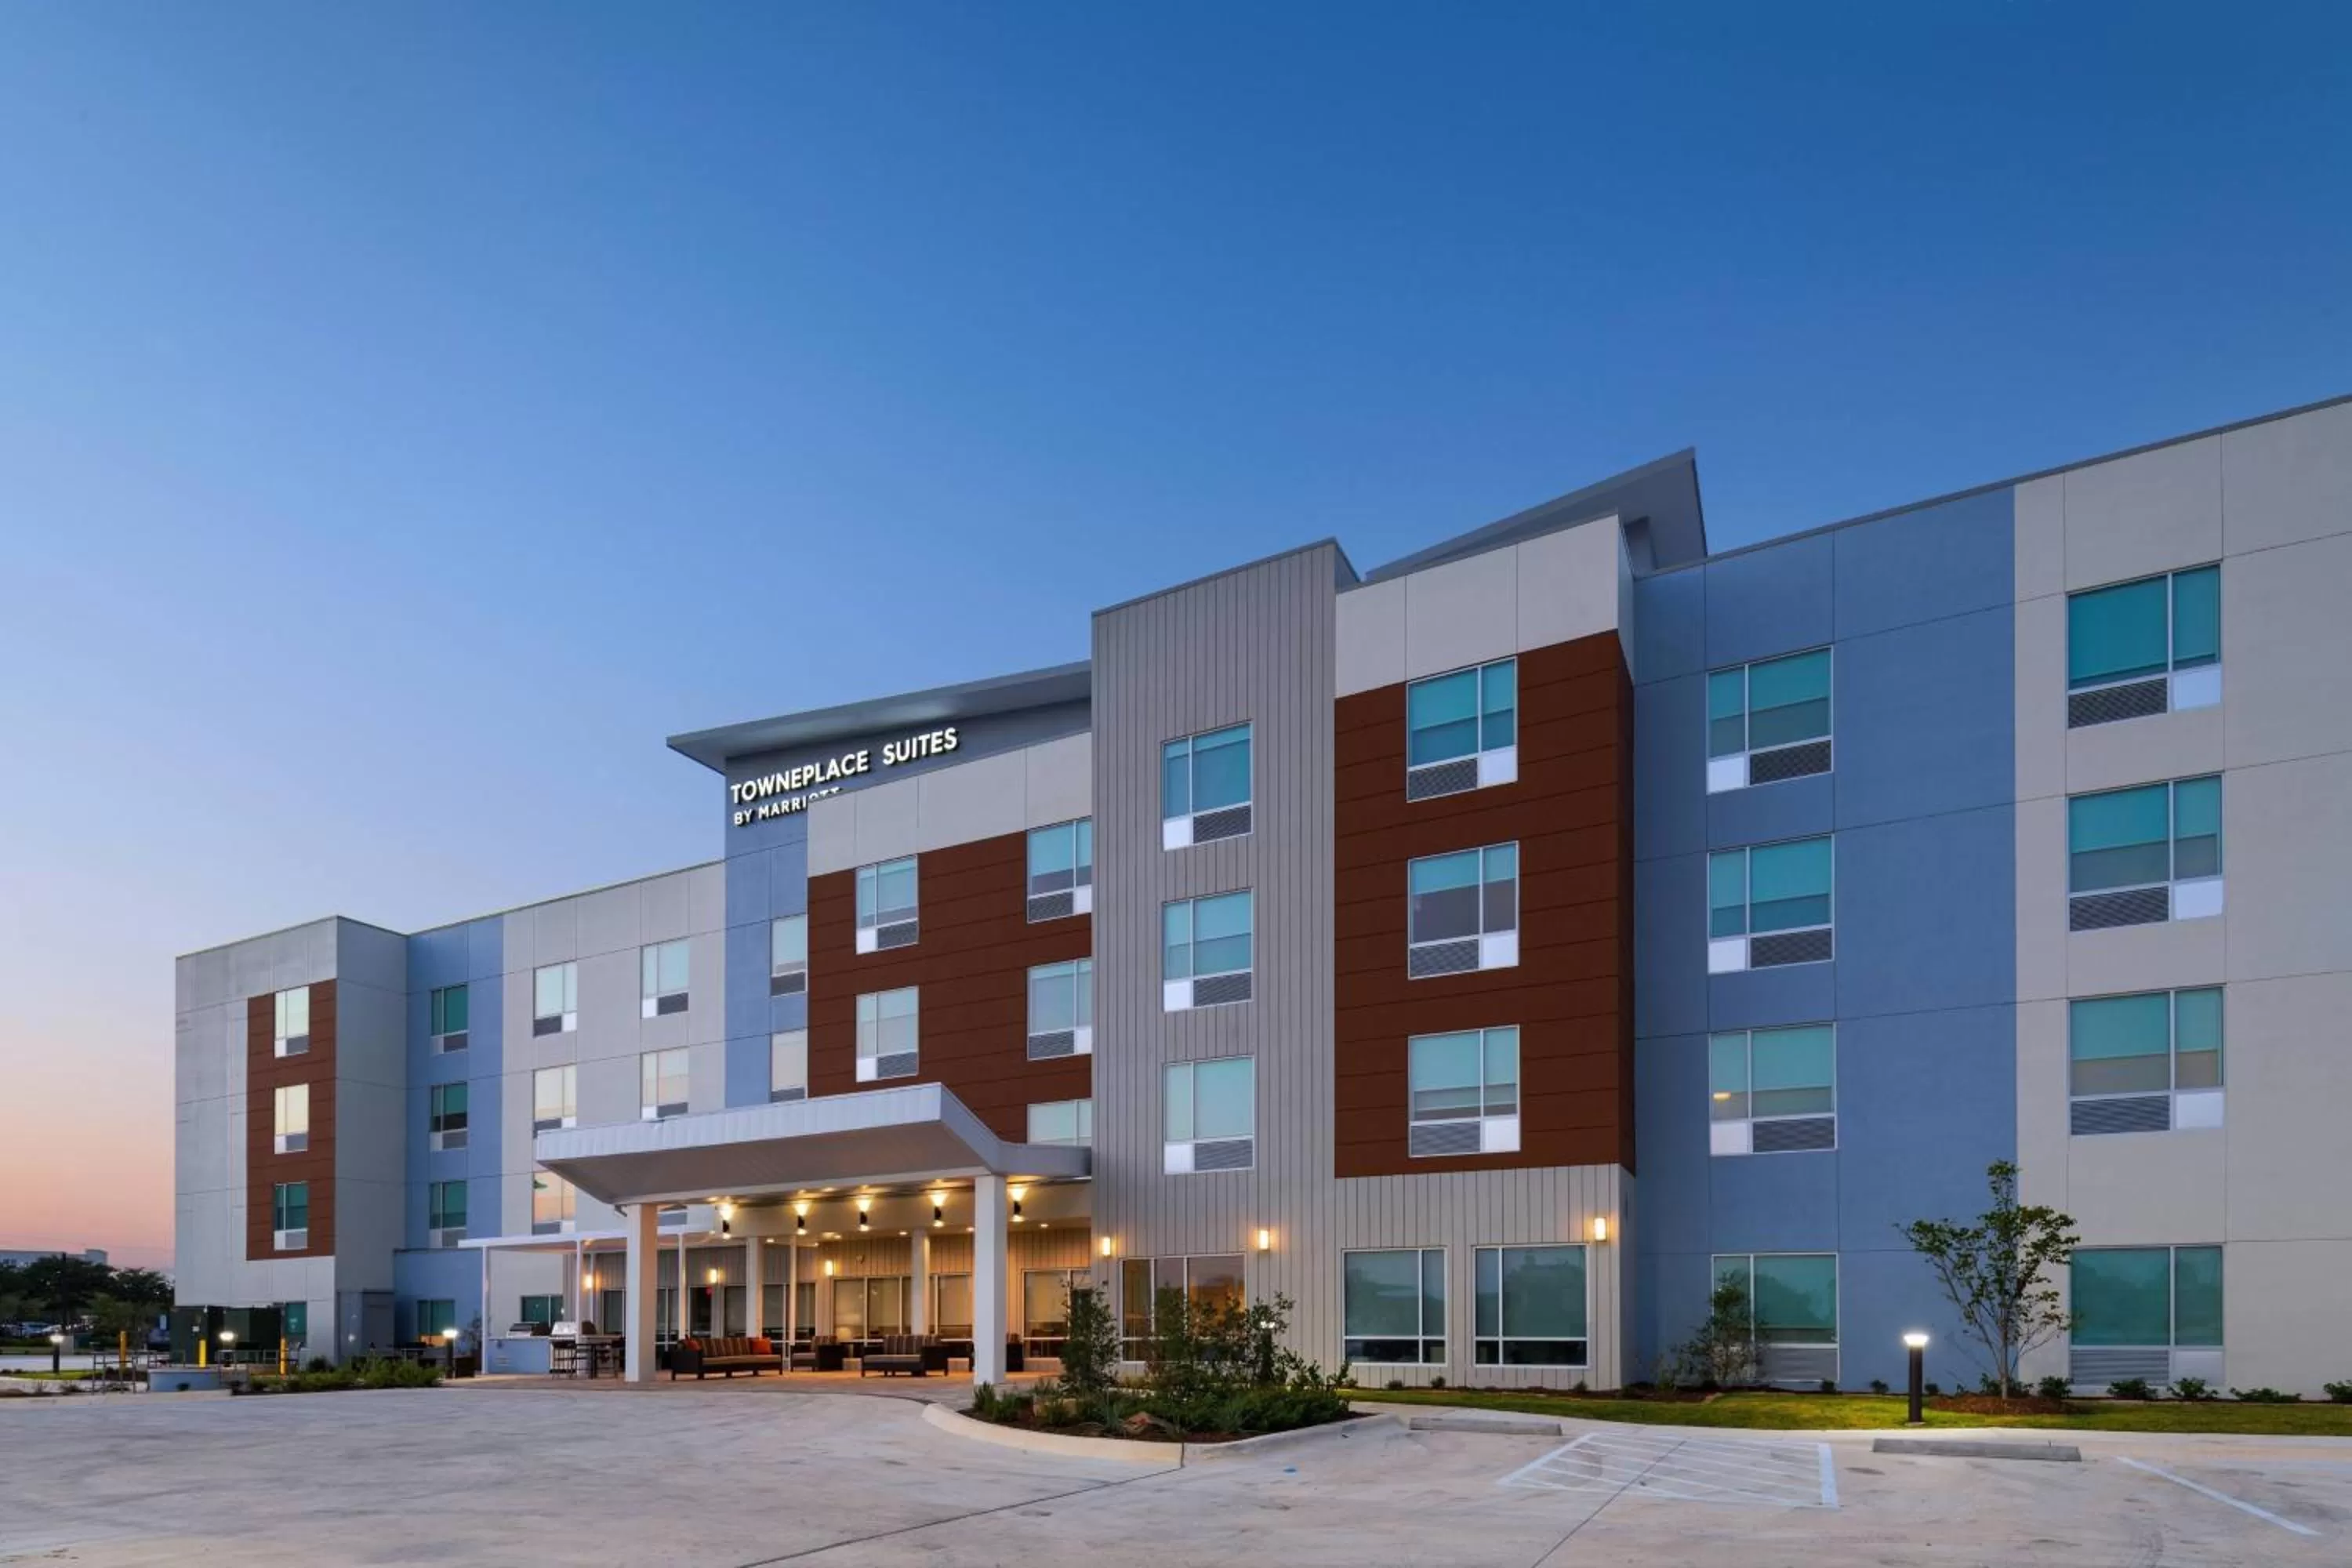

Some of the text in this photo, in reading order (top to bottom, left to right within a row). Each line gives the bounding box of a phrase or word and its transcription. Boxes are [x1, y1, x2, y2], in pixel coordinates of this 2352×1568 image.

[731, 728, 957, 804] TOWNEPLACE SUITES
[734, 810, 753, 826] BY
